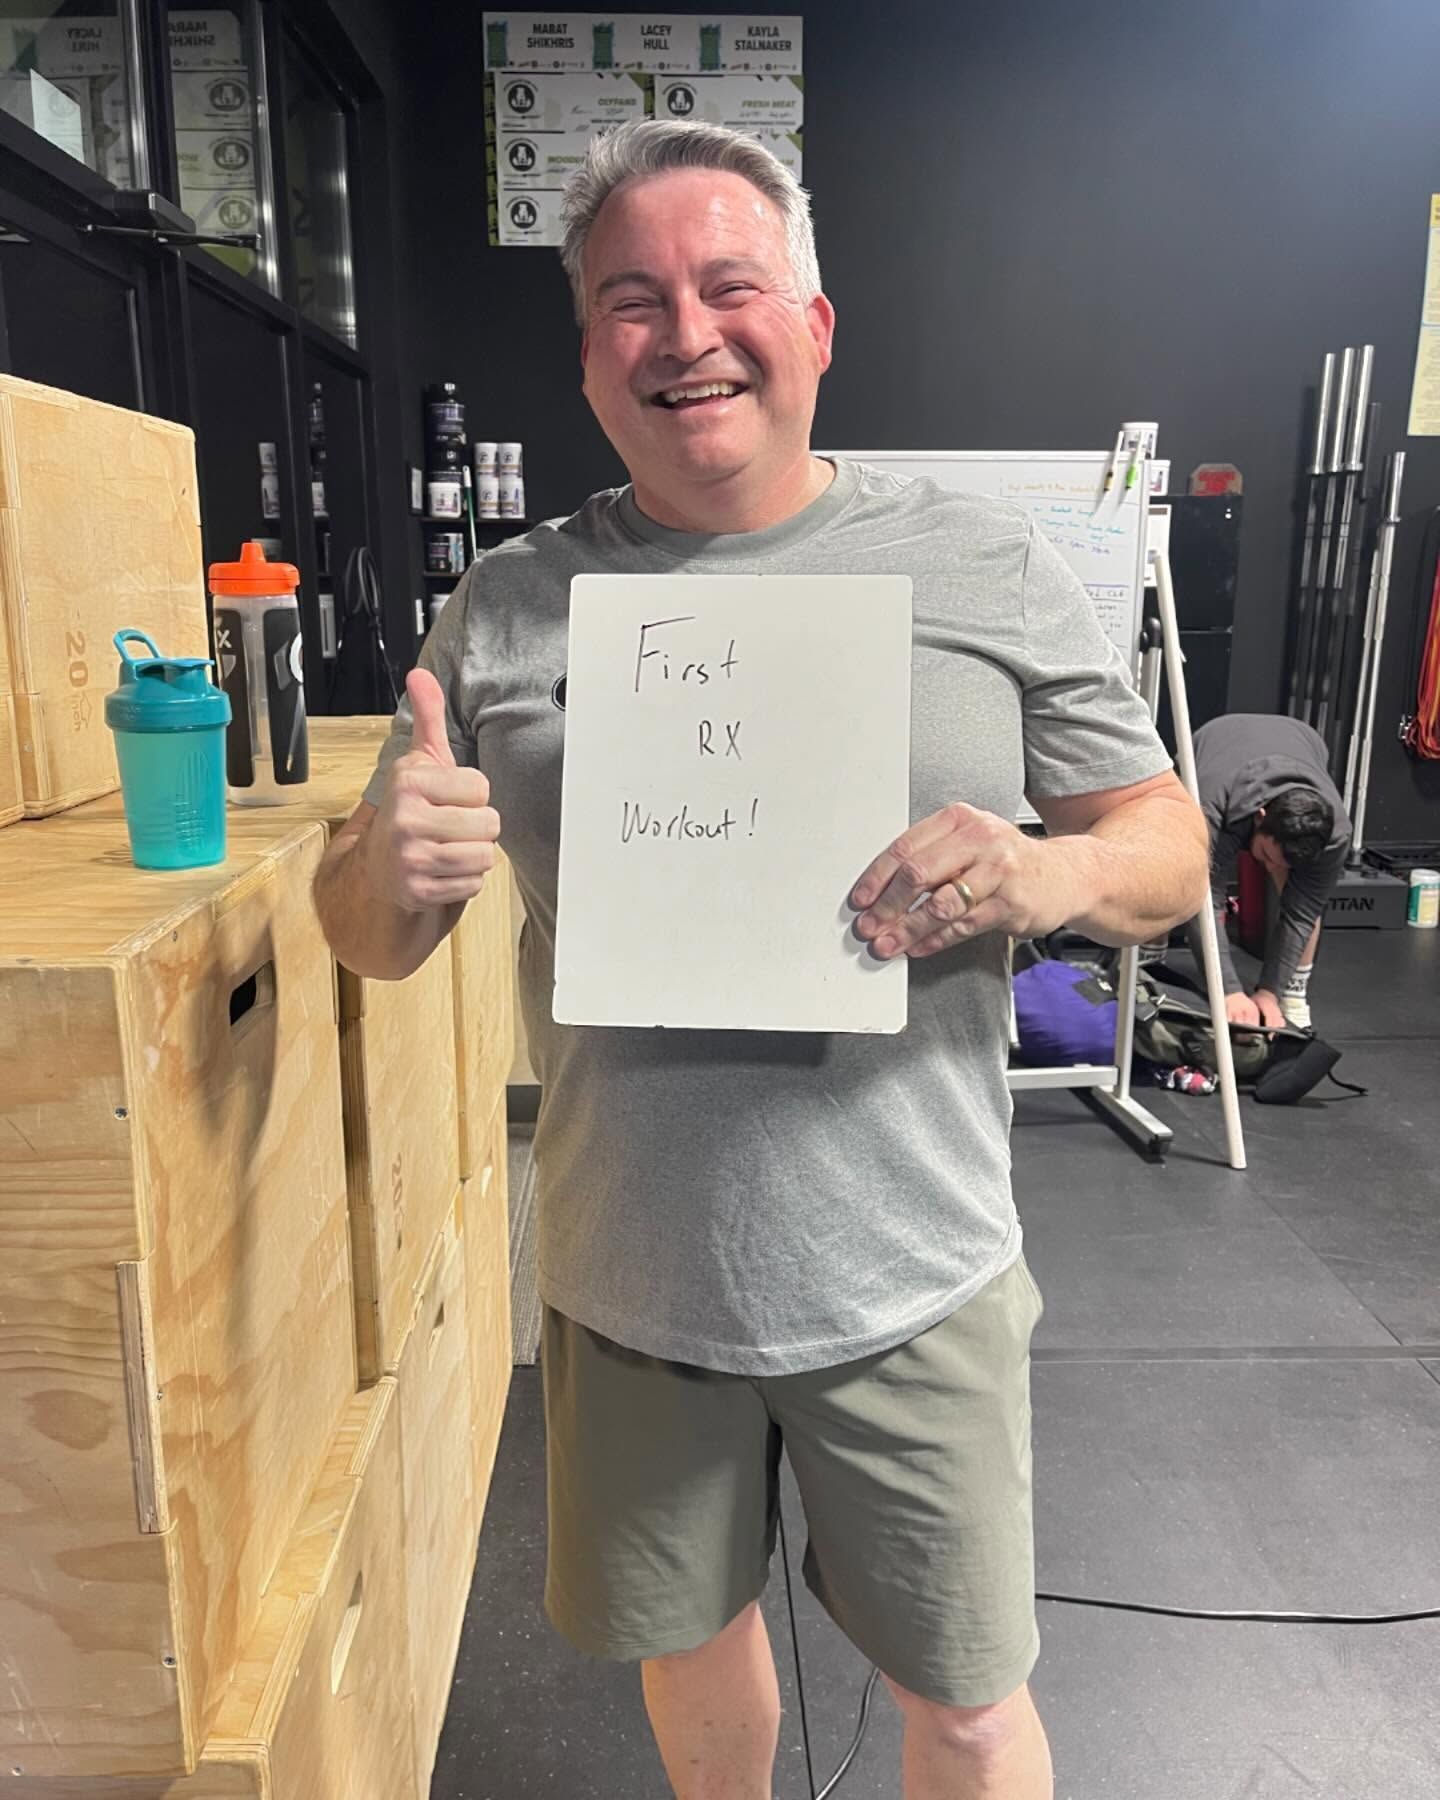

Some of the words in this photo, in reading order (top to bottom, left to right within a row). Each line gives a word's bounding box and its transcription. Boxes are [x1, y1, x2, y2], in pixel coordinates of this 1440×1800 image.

[533, 23, 568, 35] MARAT
[641, 24, 672, 37] LACEY
[747, 25, 780, 38] KAYLA
[526, 36, 575, 49] SHIKHRIS
[643, 37, 669, 50] HULL
[735, 39, 792, 52] STALNAKER
[741, 100, 770, 108] FRESH
[634, 616, 740, 693] First
[621, 797, 759, 844] Workout!
